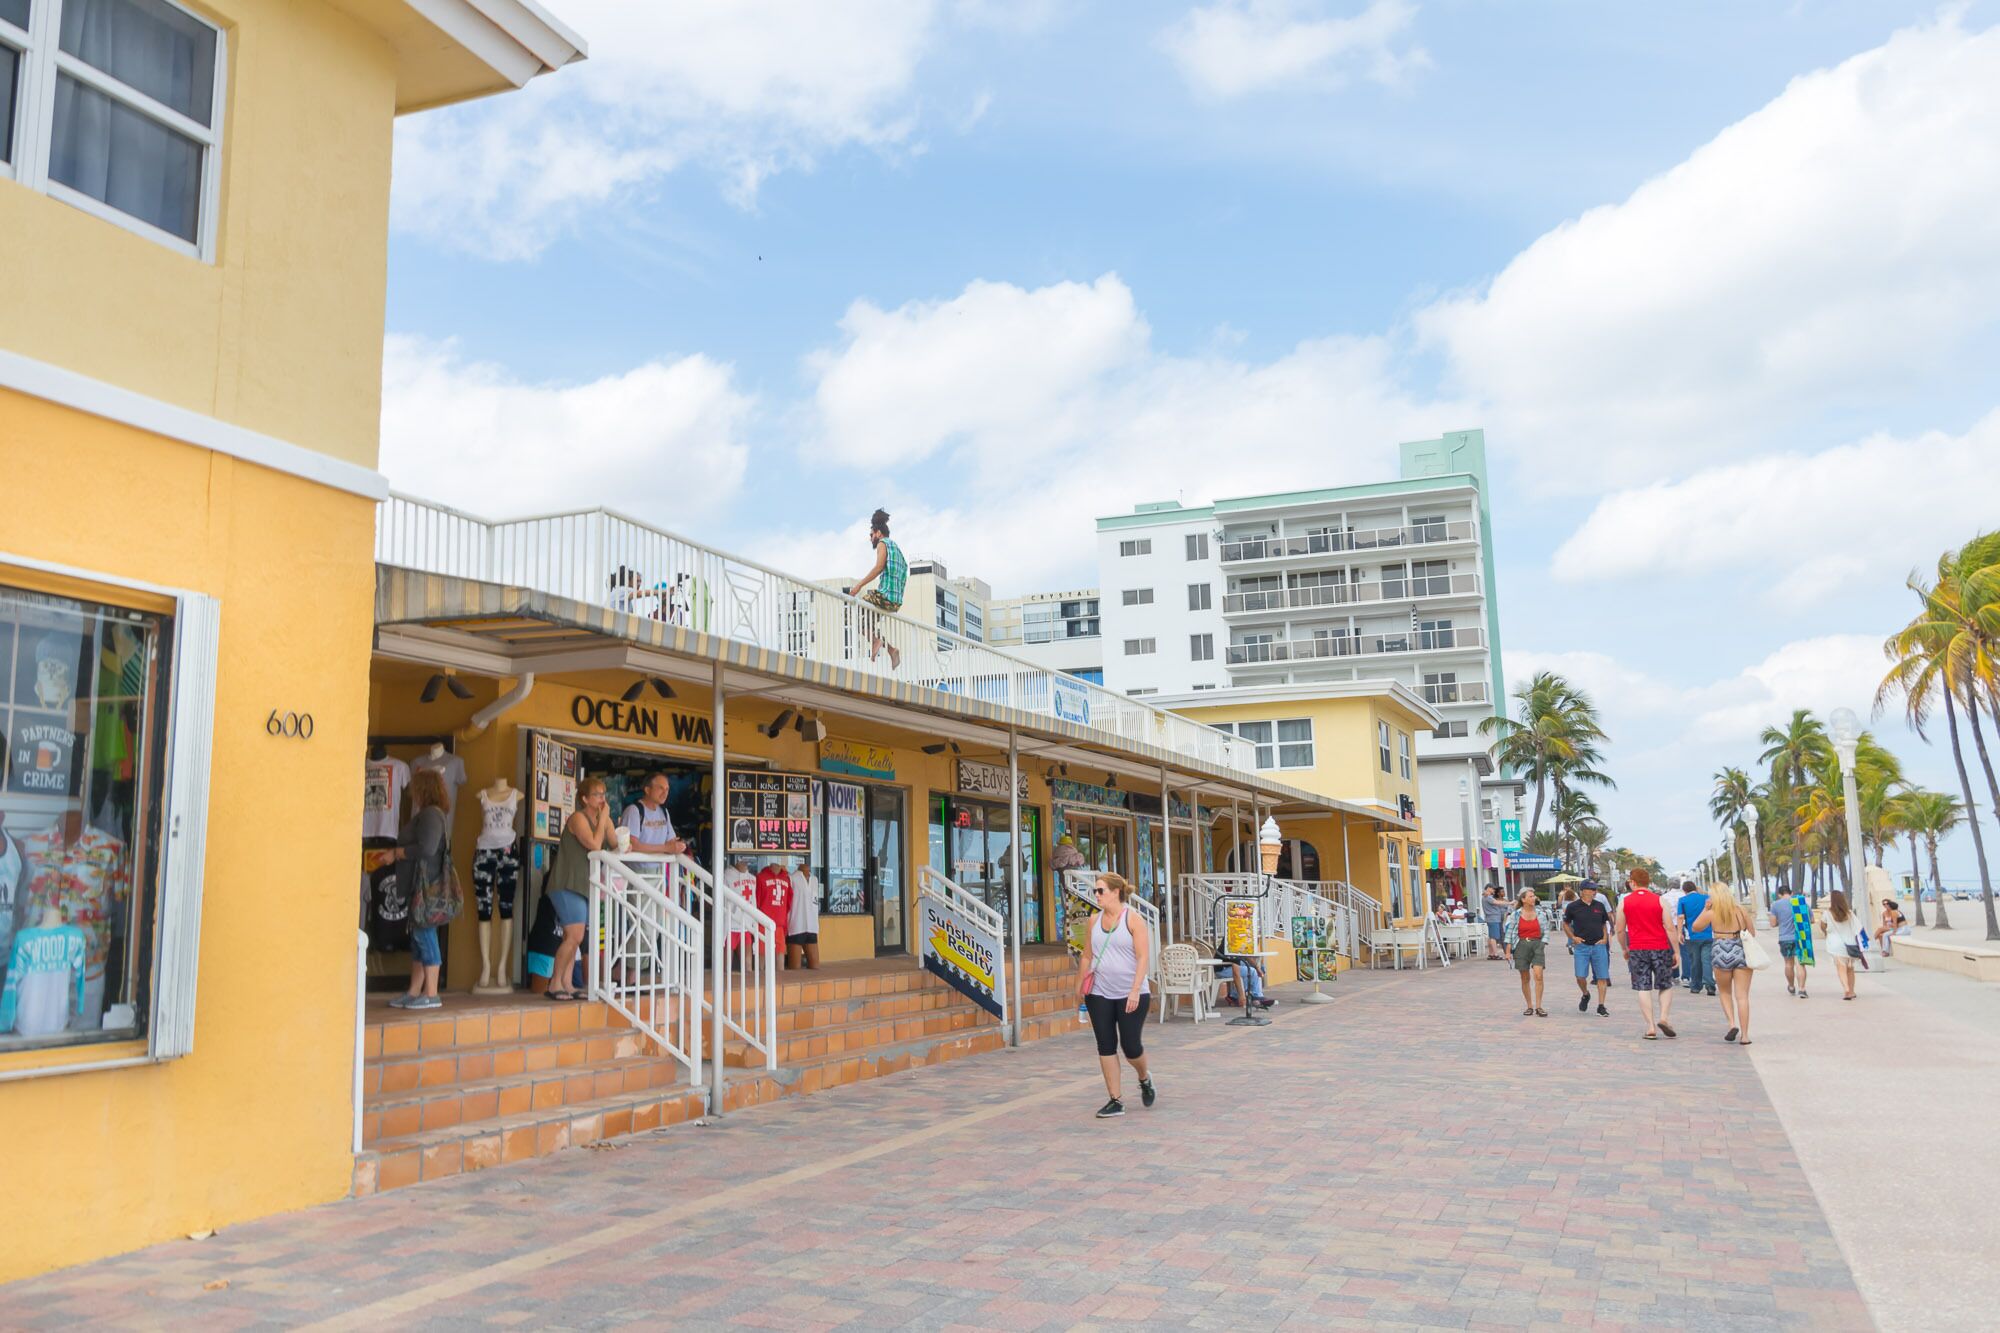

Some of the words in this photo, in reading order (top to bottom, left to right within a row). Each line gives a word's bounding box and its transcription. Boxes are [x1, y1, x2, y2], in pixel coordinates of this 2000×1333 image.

[1031, 590, 1091, 601] CRYSTAL
[266, 708, 314, 739] 600
[572, 695, 658, 737] OCEAN
[672, 712, 729, 748] WAV
[21, 725, 76, 748] PARTNERS
[18, 749, 31, 763] IN
[823, 740, 862, 764] Sunshine
[866, 750, 894, 771] Realty
[22, 771, 65, 790] CRIME
[760, 783, 780, 791] KING
[981, 767, 1011, 795] Edy's
[829, 783, 857, 810] NOW!
[928, 908, 993, 961] Sunshine
[948, 934, 993, 976] Realty
